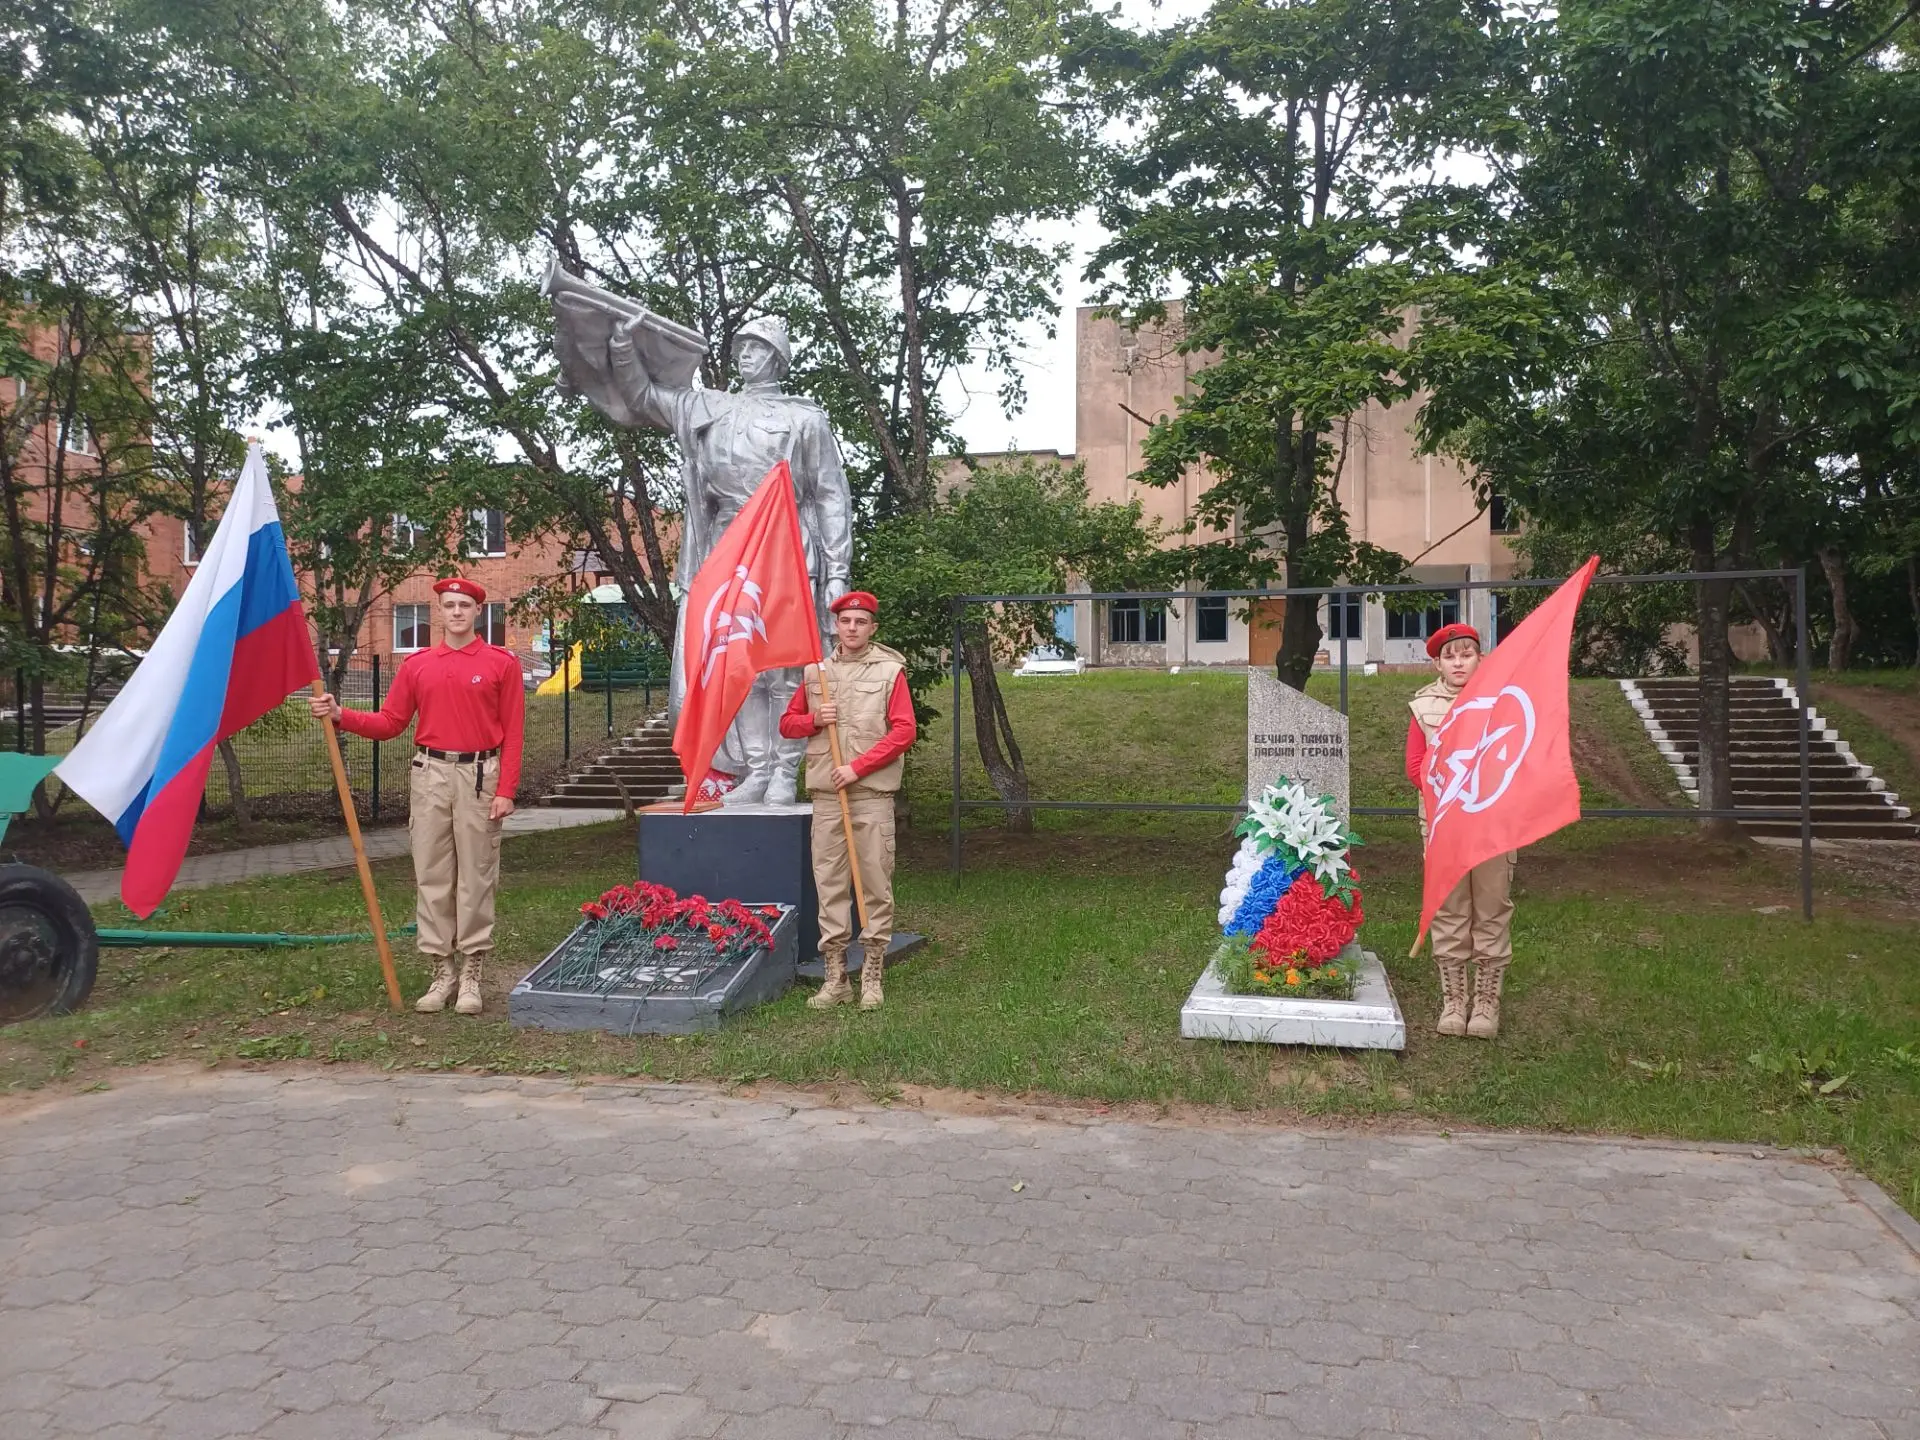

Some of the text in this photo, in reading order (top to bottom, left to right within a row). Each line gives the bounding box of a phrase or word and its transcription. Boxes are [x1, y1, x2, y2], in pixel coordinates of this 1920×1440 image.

[1254, 734, 1343, 745] ВЕЧНАЯ ПАМЯТЬ
[1254, 747, 1344, 758] ПАВШИМ ГЕРОЯМ
